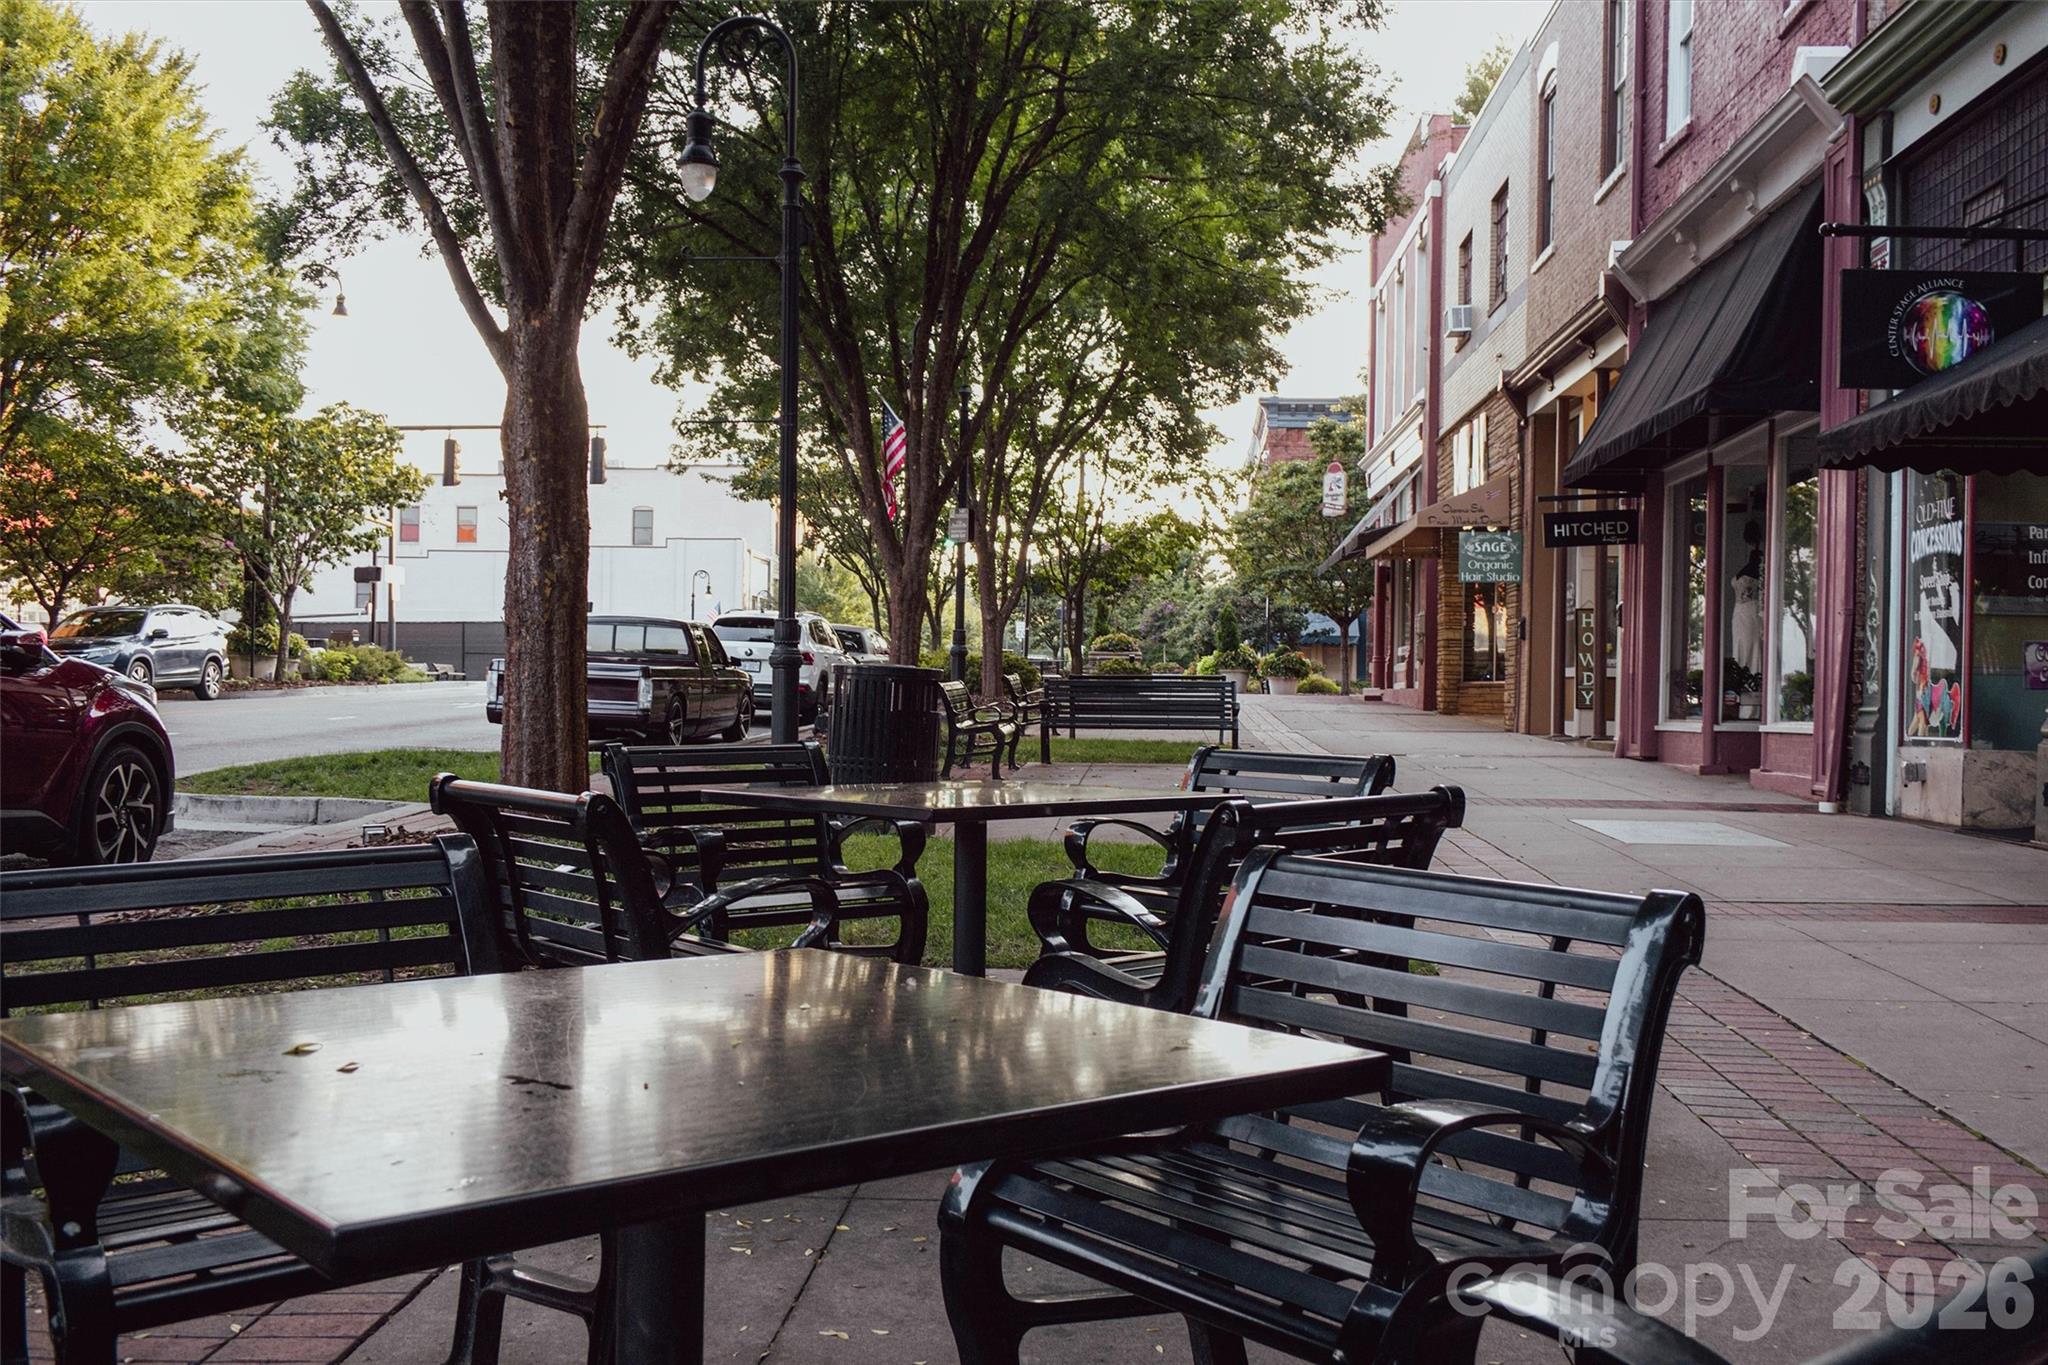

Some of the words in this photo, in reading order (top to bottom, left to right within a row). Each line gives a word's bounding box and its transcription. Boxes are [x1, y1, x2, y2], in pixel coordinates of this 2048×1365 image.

[1888, 318, 1899, 357] CENTER
[1894, 290, 1918, 317] STAGE
[1917, 278, 1966, 295] ALLIANCE
[1553, 521, 1629, 537] HITCHED
[1474, 541, 1508, 553] SAGE
[1911, 519, 1963, 563] CONCESSIONS
[1467, 559, 1514, 572] Organic
[1461, 571, 1484, 581] Hair
[1486, 571, 1520, 581] Studio
